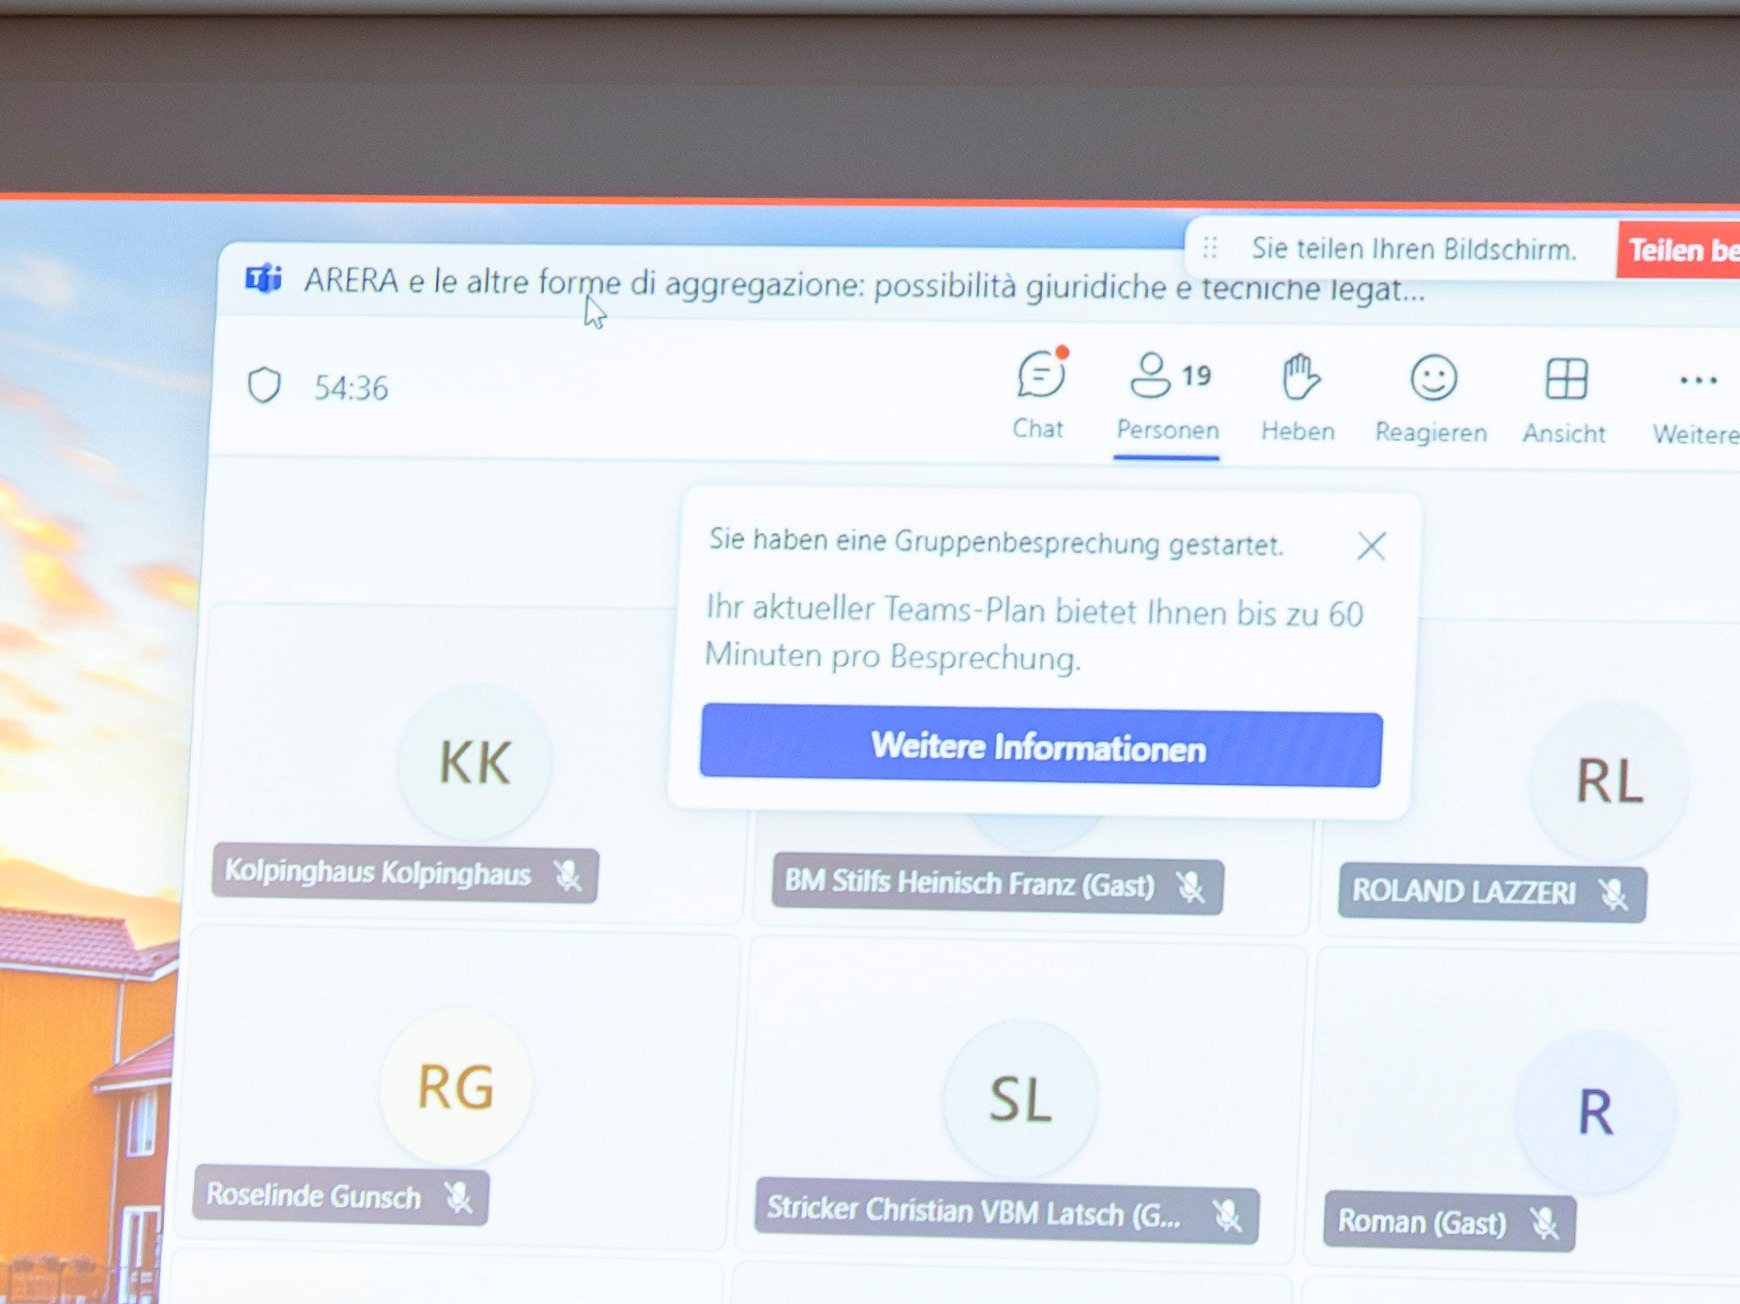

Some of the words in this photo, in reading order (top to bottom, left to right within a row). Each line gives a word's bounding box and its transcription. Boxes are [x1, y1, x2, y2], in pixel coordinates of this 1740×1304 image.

[1253, 236, 1288, 259] Sie
[1298, 237, 1363, 259] teilen
[1373, 238, 1434, 260] Ihren
[1445, 237, 1577, 262] Bildschirm.
[1630, 239, 1703, 262] Teilen
[304, 267, 398, 294] ARERA
[409, 274, 425, 294] e
[434, 267, 457, 294] le
[467, 268, 528, 294] altre
[539, 268, 621, 295] forme
[631, 269, 655, 295] di
[666, 272, 865, 303] aggregazione:
[875, 271, 1016, 304] possibilità
[1026, 274, 1166, 305] giuridiche
[1176, 281, 1192, 300] e
[1203, 279, 1320, 300] tecniche
[314, 376, 388, 401] 54:36
[1183, 366, 1211, 387] 19
[1013, 419, 1063, 438] Chat
[1117, 420, 1219, 440] Personen
[1262, 421, 1335, 441] Heben
[1375, 422, 1487, 447] Reagieren
[1523, 423, 1606, 445] Ansicht
[1653, 425, 1740, 446] Weitere
[710, 527, 744, 551] Sie
[753, 529, 827, 552] haben
[837, 531, 886, 553] eine
[894, 530, 1159, 559] Gruppenbesprechung
[1169, 535, 1283, 560] gestartet.
[708, 593, 744, 619] Ihr
[753, 594, 875, 621] aktueller
[885, 595, 1045, 623] Teams-Plan
[1056, 597, 1137, 624] bietet
[1148, 599, 1226, 625] Ihnen
[1237, 599, 1277, 626] bis
[1287, 607, 1319, 627] zu
[1328, 601, 1364, 627] 60
[705, 641, 822, 667] Minuten
[833, 649, 880, 674] pro
[892, 644, 1080, 677] Besprechung.
[872, 730, 985, 760] Weitere
[994, 732, 1207, 764] Informationen
[441, 741, 512, 784] KK
[1577, 758, 1643, 803] RL
[226, 858, 374, 886] Kolpinghaus
[381, 860, 531, 889] Kolpinghaus
[785, 867, 825, 892] BM
[832, 868, 890, 893] Stilfs
[899, 870, 1001, 896] Heinisch
[1009, 872, 1075, 897] Franz
[1082, 874, 1155, 901] (Gast)
[1353, 878, 1465, 903] ROLAND
[1472, 880, 1576, 905] LAZZERI
[418, 1064, 493, 1109] RG
[990, 1076, 1052, 1121] SL
[207, 1181, 324, 1208] Roselinde
[330, 1184, 421, 1211] Gunsch
[768, 1195, 858, 1221] Stricker
[866, 1197, 973, 1224] Christian
[981, 1201, 1038, 1225] VBM
[1047, 1202, 1124, 1228] Latsch
[1339, 1209, 1427, 1234] Roman
[1434, 1211, 1506, 1239] (Gast)
